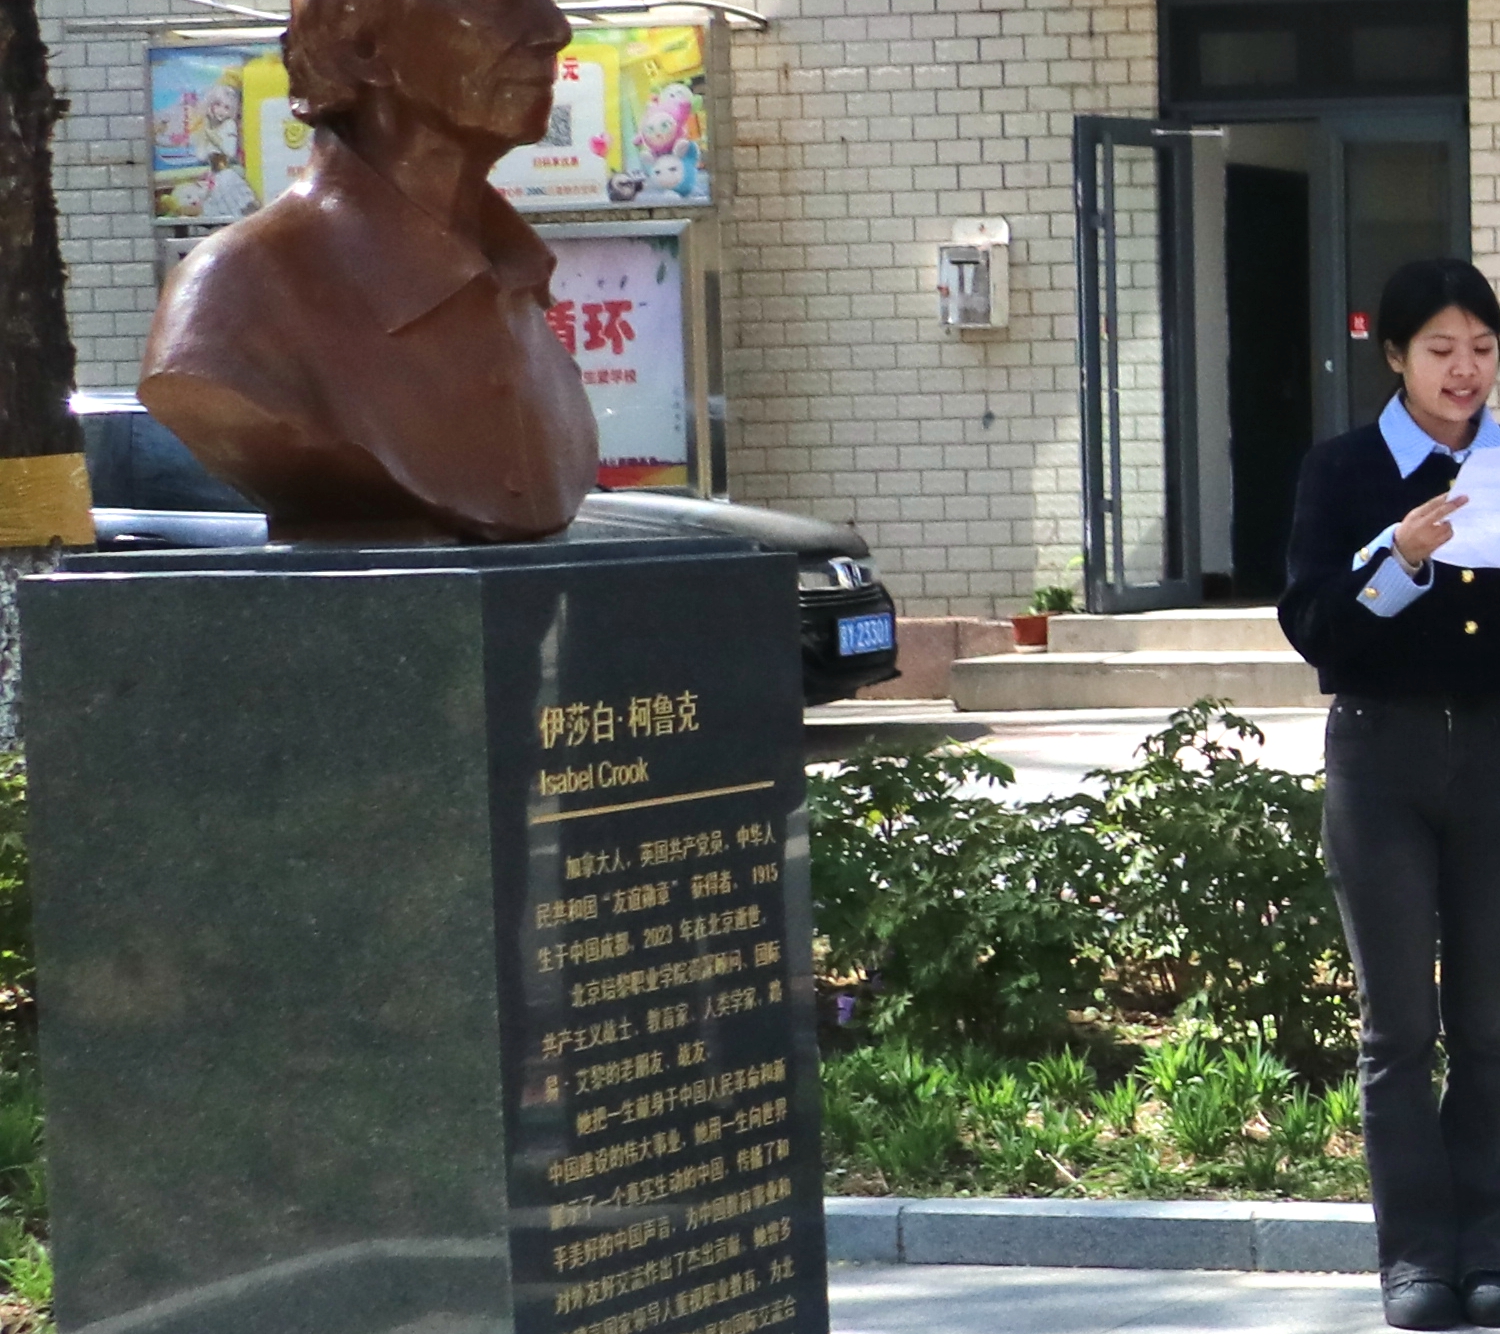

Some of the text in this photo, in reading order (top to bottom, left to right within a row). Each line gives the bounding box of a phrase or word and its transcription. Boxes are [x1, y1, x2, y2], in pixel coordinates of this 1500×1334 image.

[540, 689, 700, 750] 伊莎白·柯鲁克
[539, 756, 650, 797] Isabel Crook
